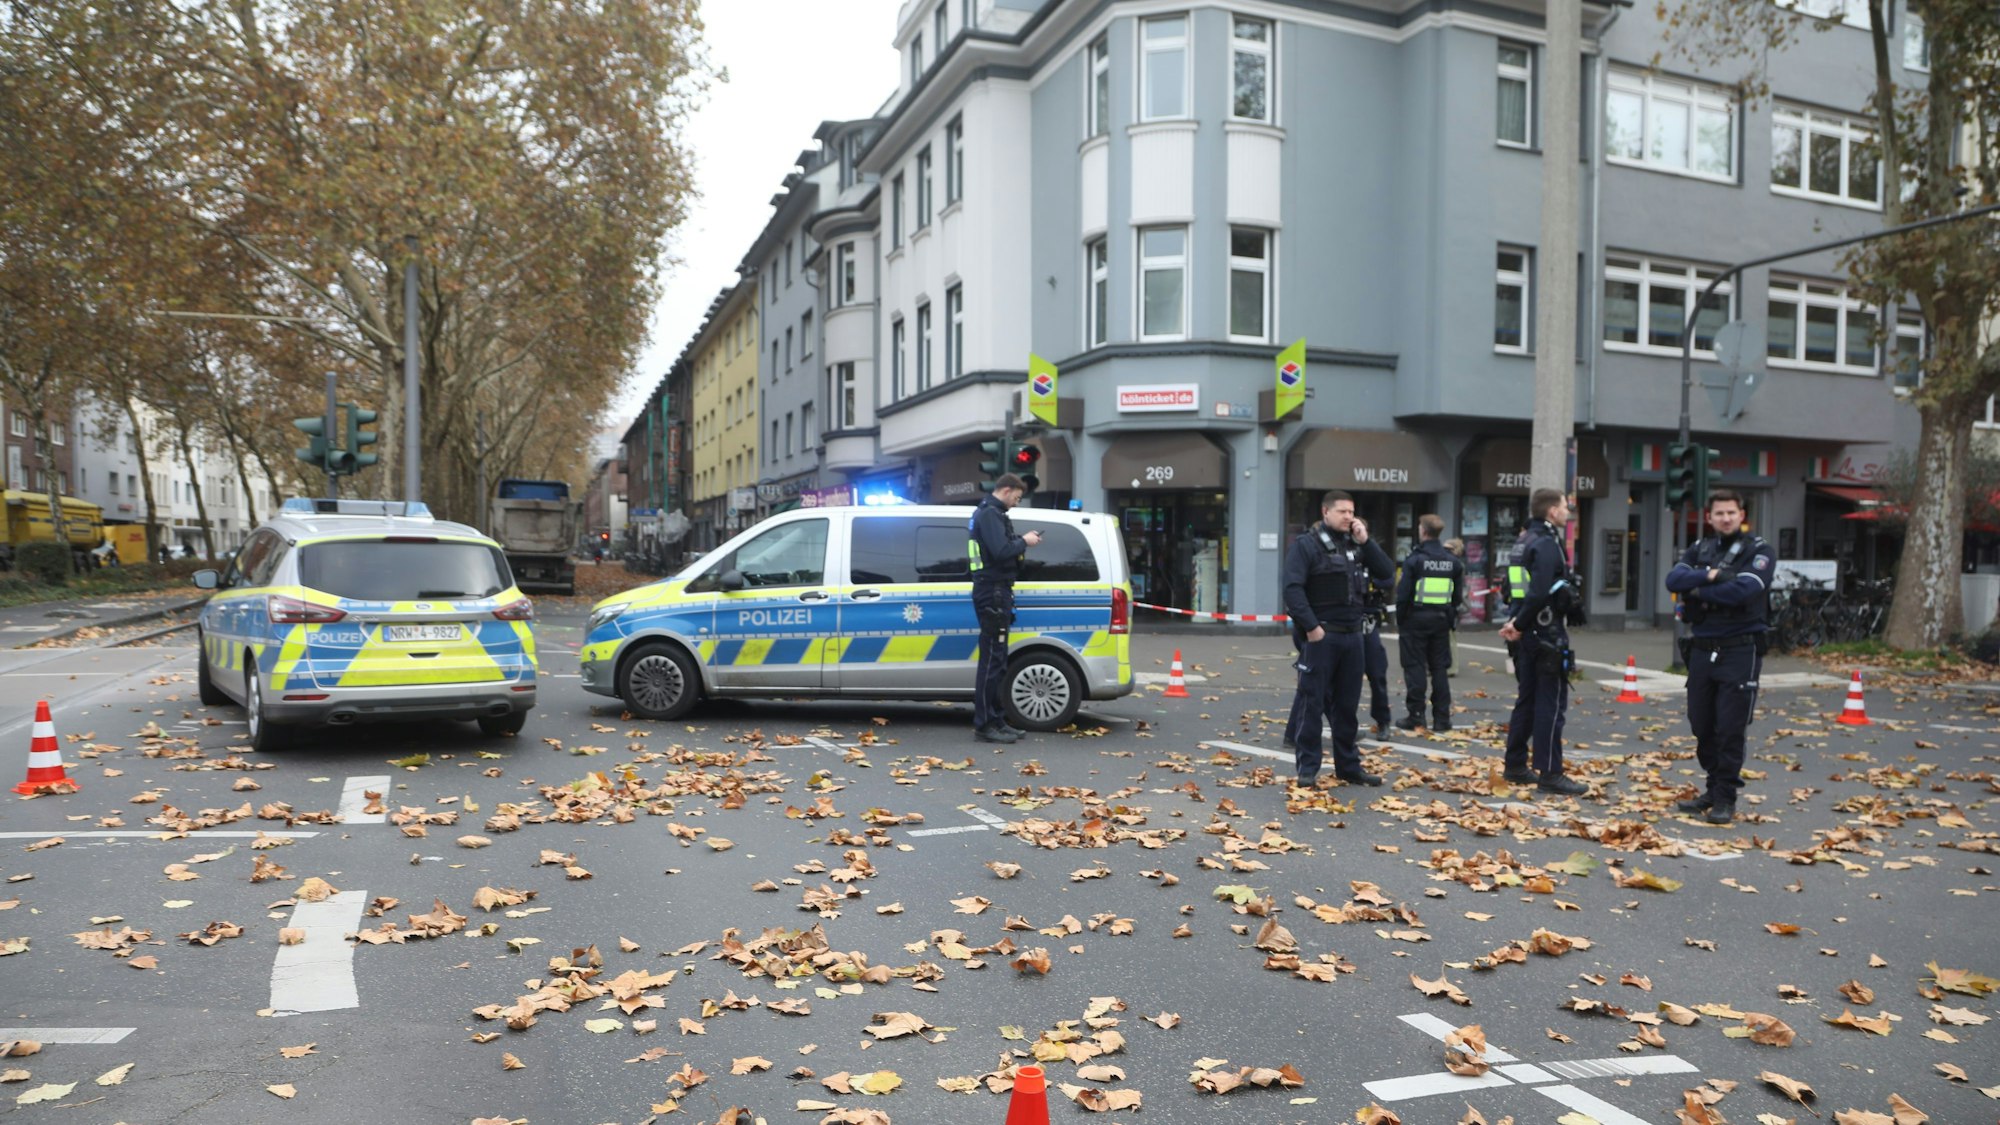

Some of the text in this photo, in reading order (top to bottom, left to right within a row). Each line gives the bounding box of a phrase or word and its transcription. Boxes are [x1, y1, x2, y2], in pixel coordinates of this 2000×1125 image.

[1146, 466, 1174, 480] 269
[1353, 468, 1409, 483] WILDEN
[1423, 560, 1453, 571] POLIZEI
[738, 608, 812, 627] POLIZEI
[309, 632, 363, 643] POLIZEI
[390, 626, 460, 640] NRW 4-9827
